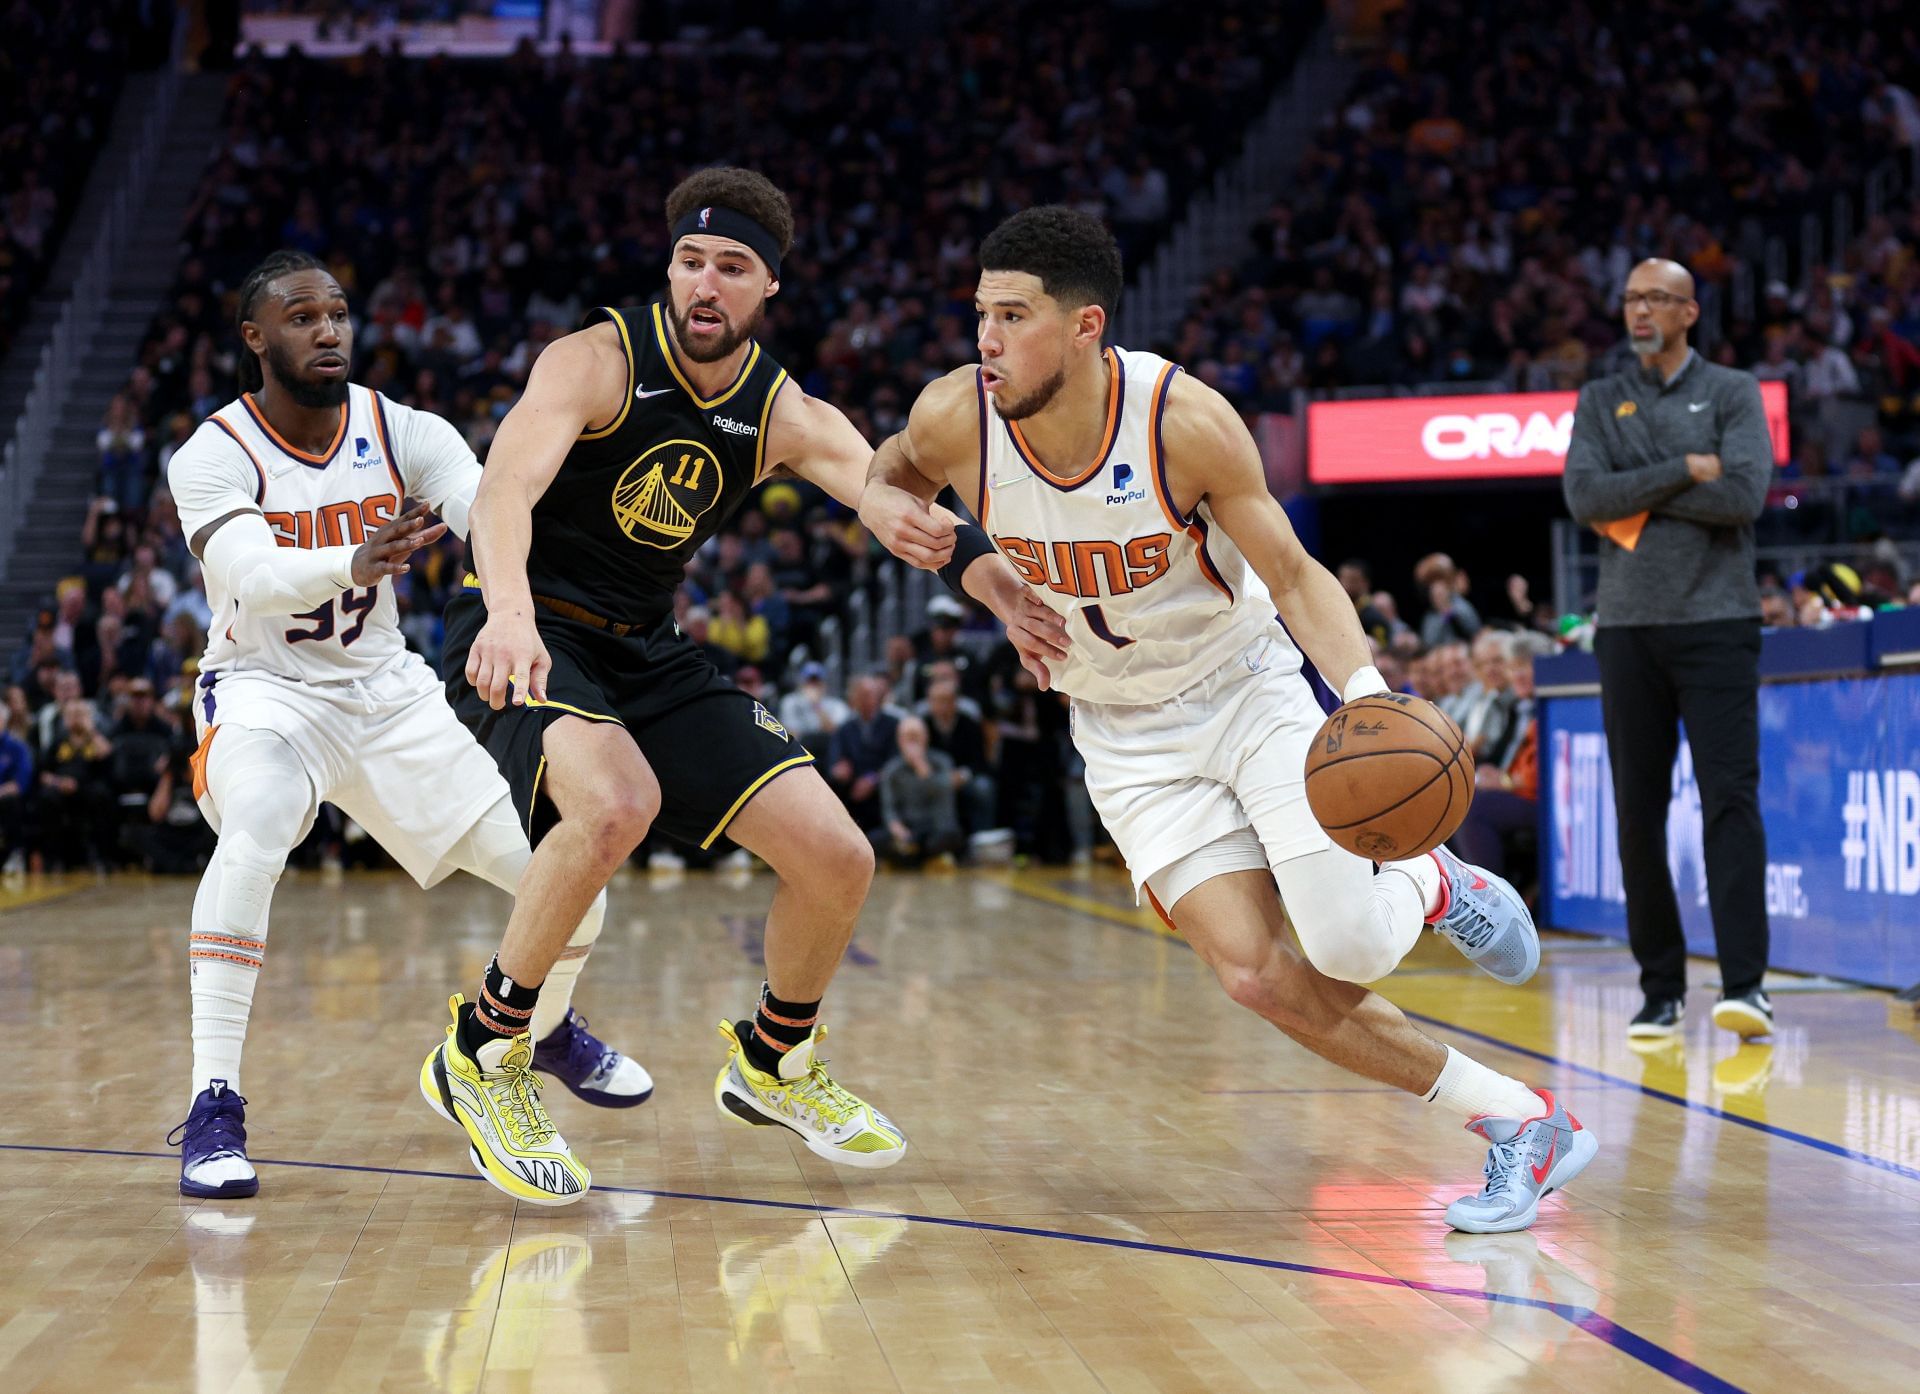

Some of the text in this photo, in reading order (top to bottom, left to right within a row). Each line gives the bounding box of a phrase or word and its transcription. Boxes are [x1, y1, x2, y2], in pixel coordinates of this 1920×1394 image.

[713, 415, 758, 436] Rakuten
[353, 457, 381, 469] PayPal
[670, 454, 705, 490] 11
[1106, 489, 1145, 505] PayPal
[992, 533, 1172, 598] SUNS
[1080, 604, 1137, 650] 1
